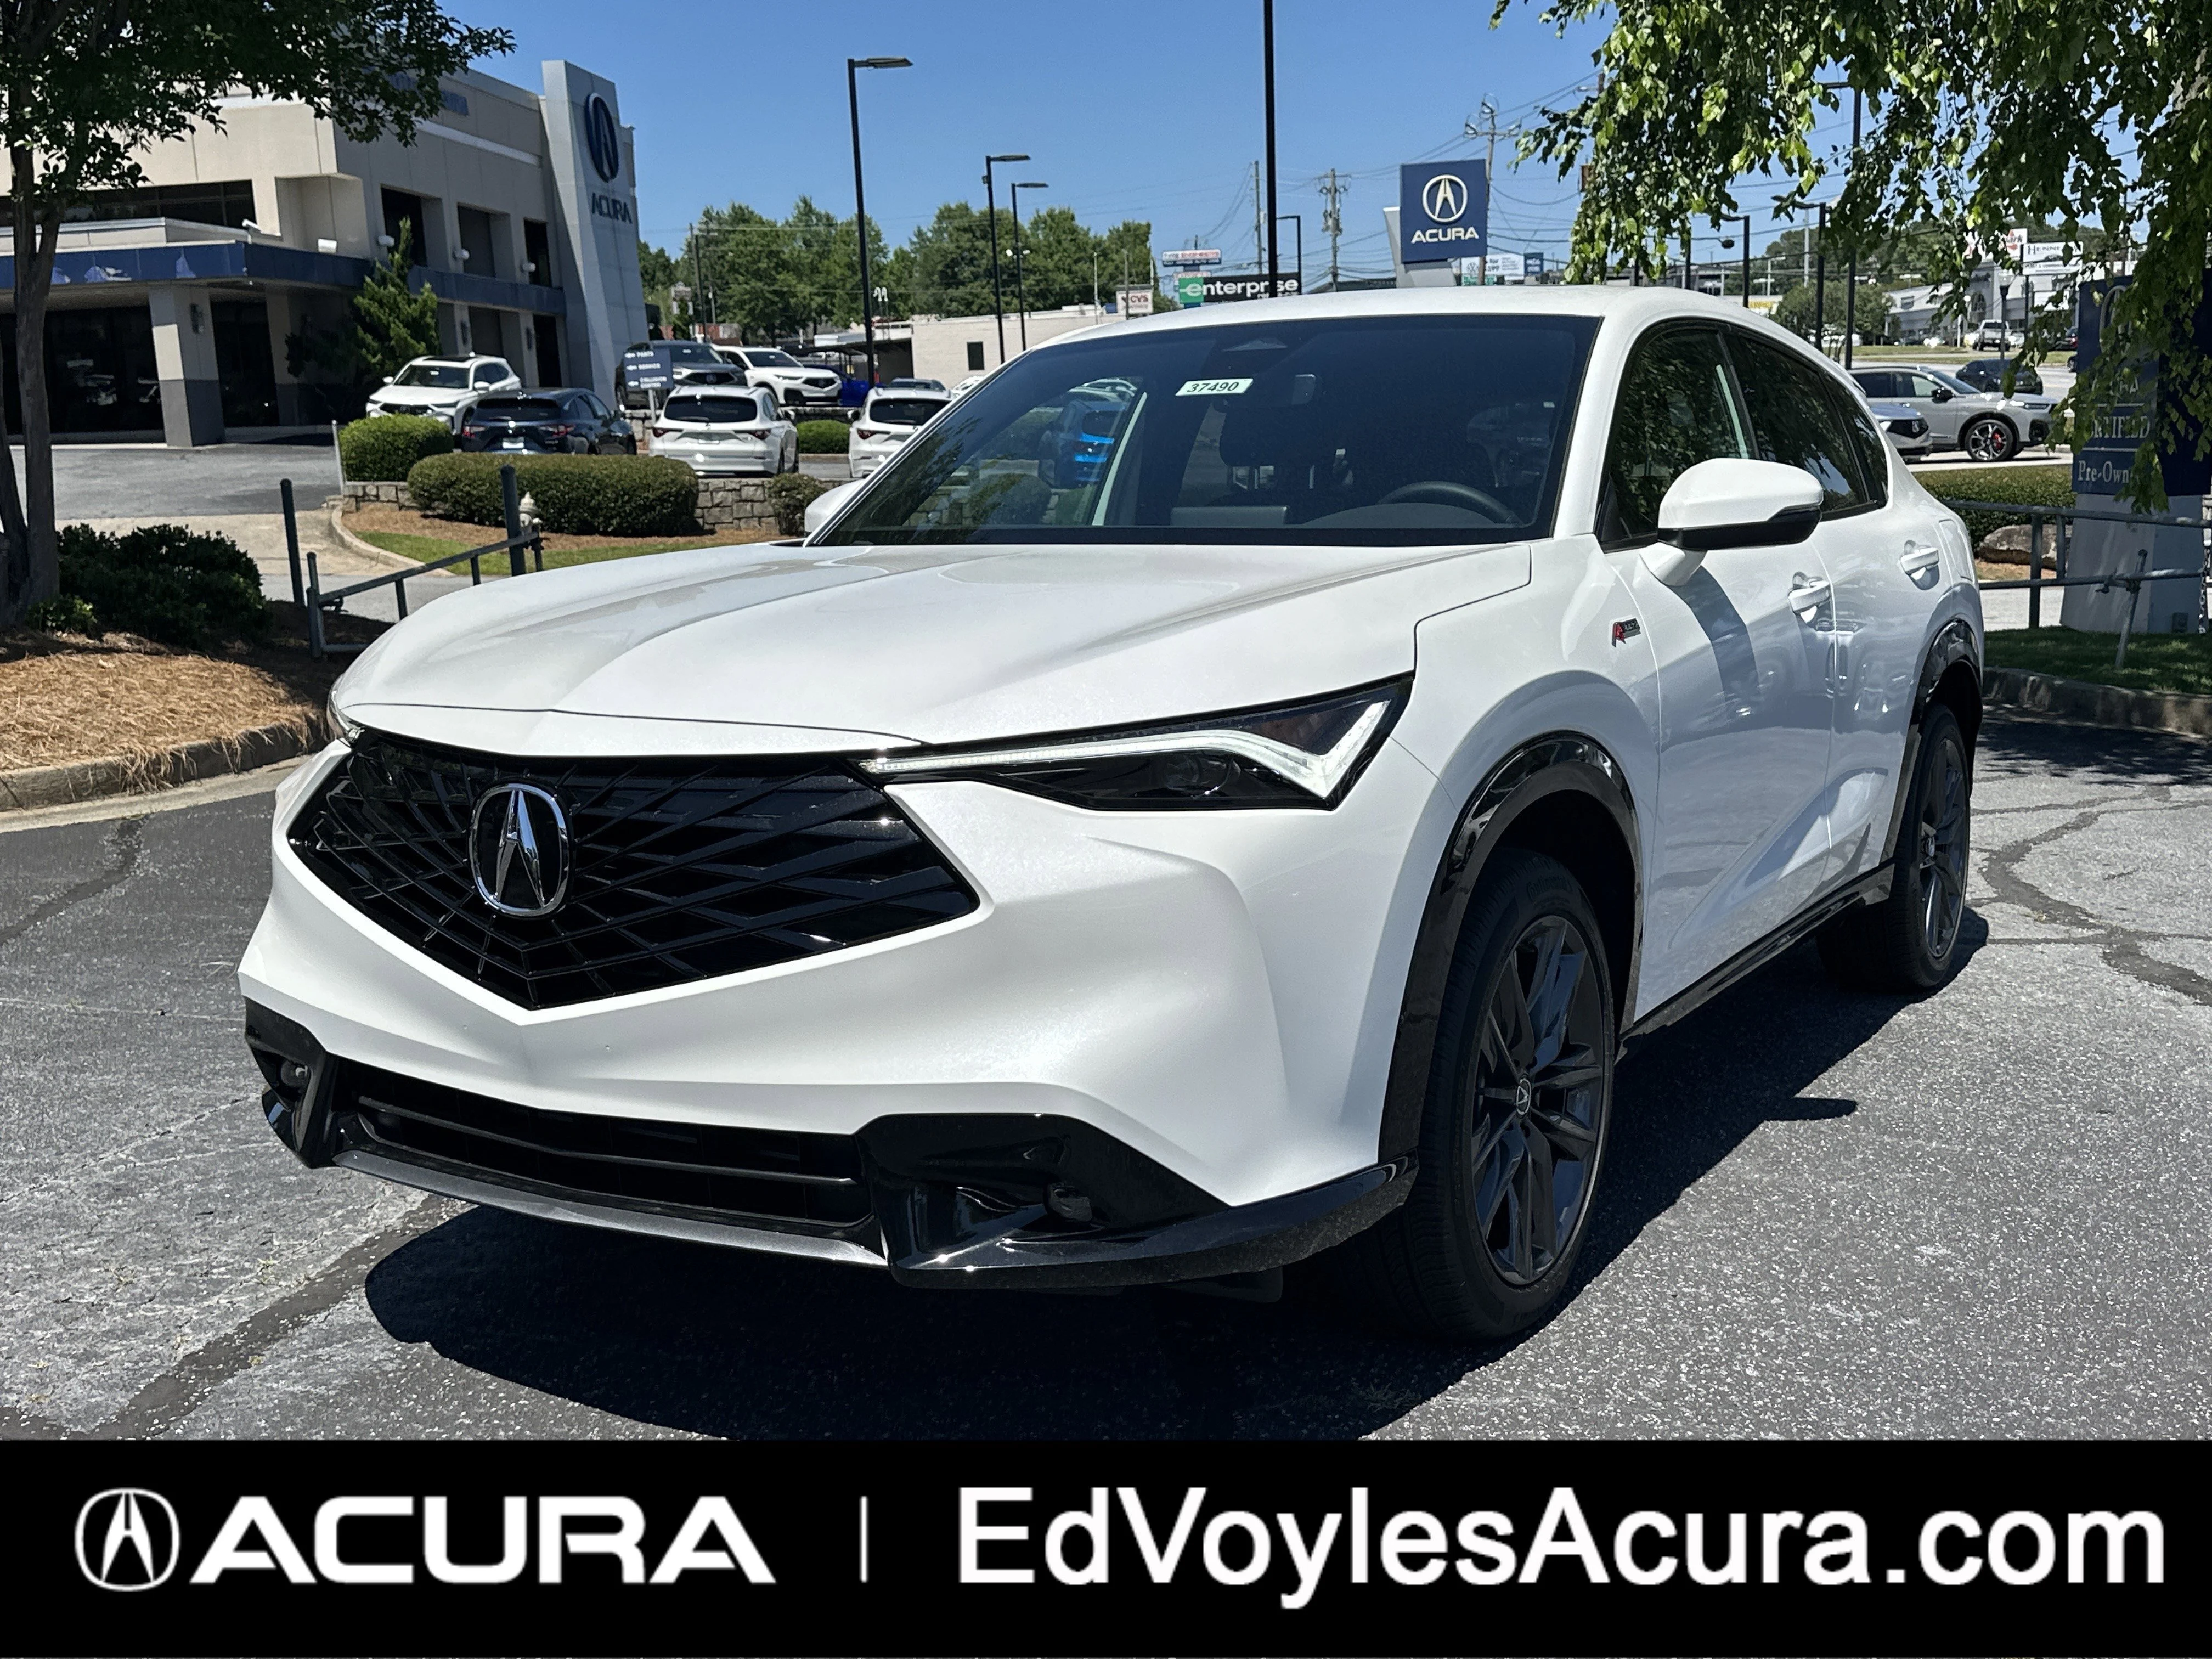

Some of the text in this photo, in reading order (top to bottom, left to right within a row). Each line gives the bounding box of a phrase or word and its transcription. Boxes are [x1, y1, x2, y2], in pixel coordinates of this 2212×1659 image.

[592, 192, 633, 224] ACURA
[1411, 227, 1479, 244] ACURA
[1180, 279, 1299, 297] enterprse
[1131, 295, 1148, 303] CVS
[1187, 382, 1239, 393] 37490
[2078, 460, 2139, 483] Pre-Own
